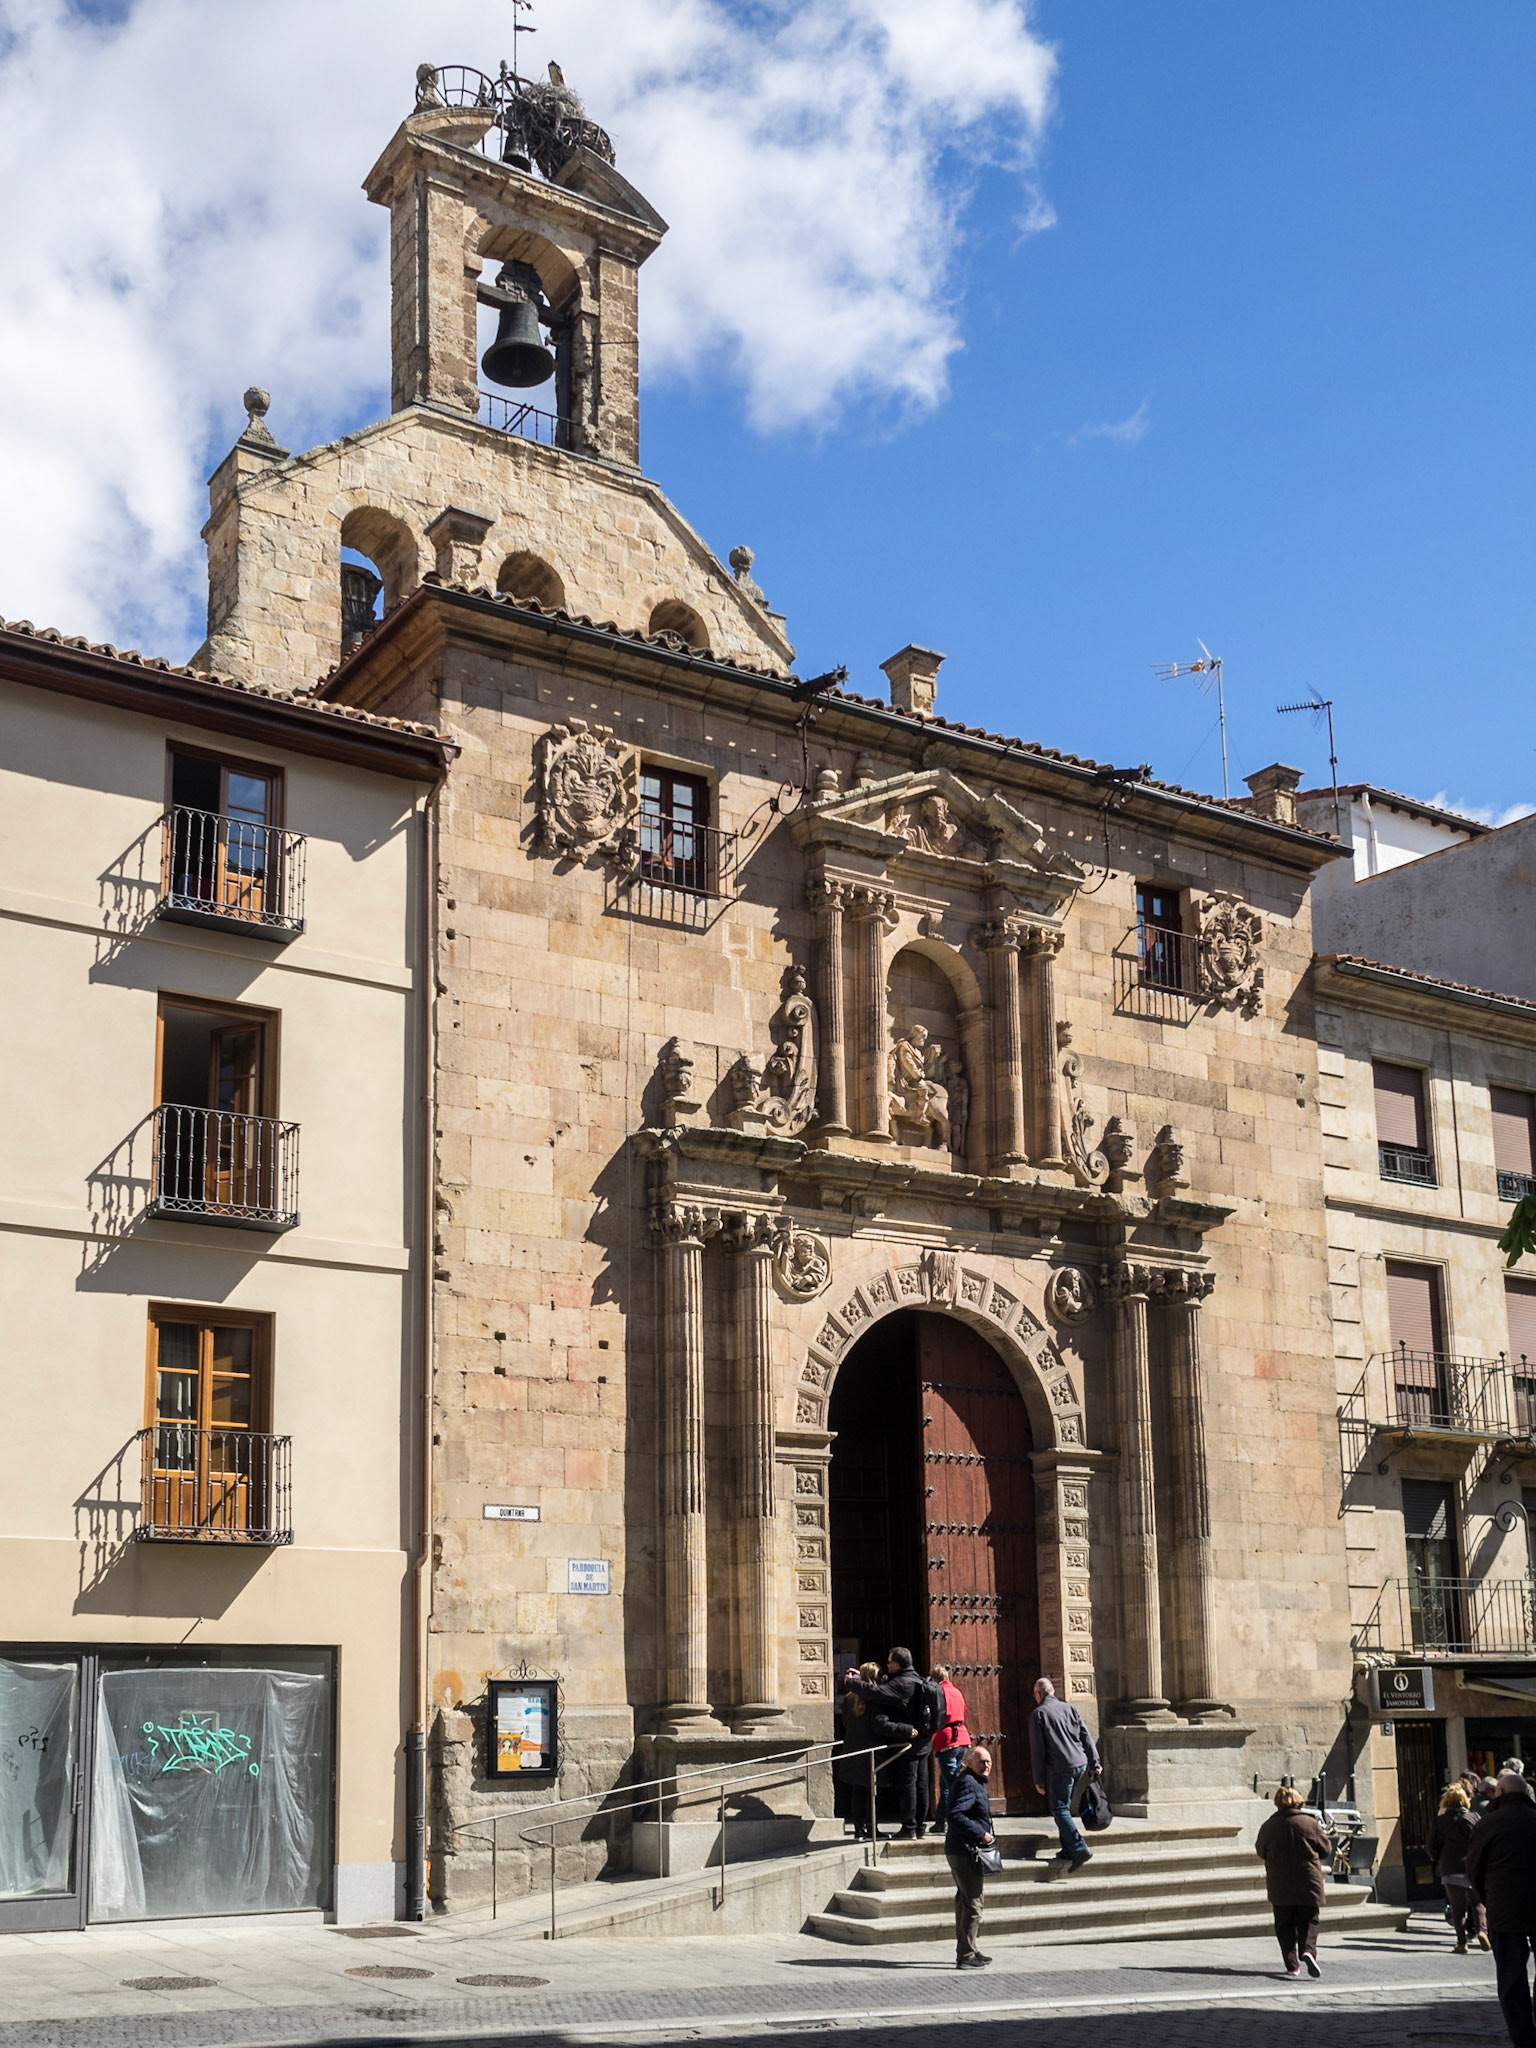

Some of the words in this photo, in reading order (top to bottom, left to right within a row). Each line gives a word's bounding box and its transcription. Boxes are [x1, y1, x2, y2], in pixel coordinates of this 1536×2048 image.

[499, 1508, 525, 1517] QUINTANA
[571, 1563, 606, 1573] PARROQUIA
[585, 1573, 594, 1581] DE
[570, 1581, 583, 1591] SAN
[1383, 1691, 1390, 1699] EL
[1390, 1691, 1422, 1699] VENTORRO
